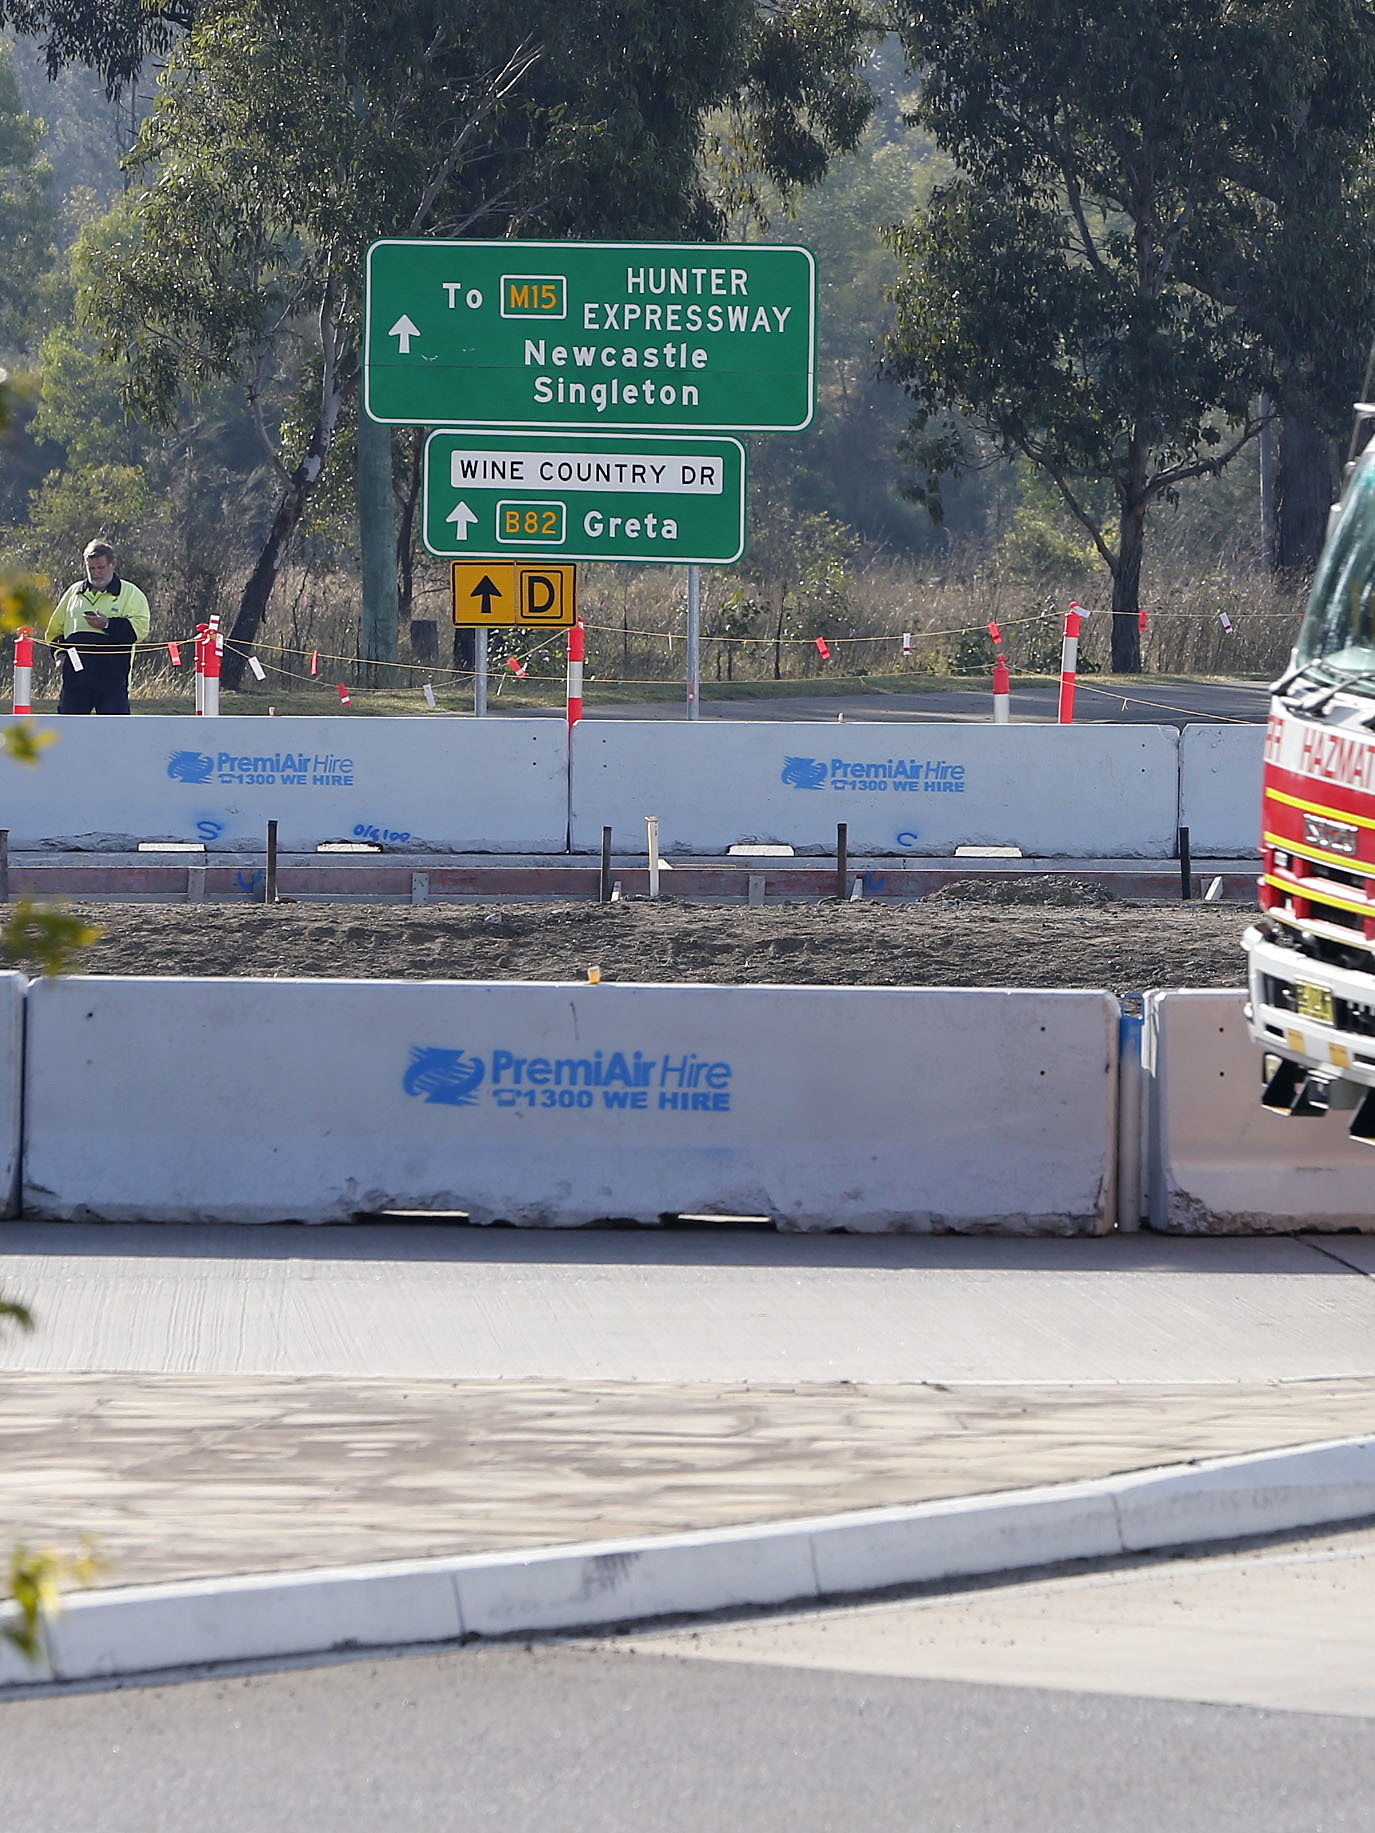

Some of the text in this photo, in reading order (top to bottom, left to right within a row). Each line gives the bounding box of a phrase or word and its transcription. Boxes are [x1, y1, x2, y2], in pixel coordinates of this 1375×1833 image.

[628, 268, 748, 295] HUNTER
[442, 282, 483, 309] To
[510, 284, 557, 309] M15
[584, 304, 792, 333] EXPRESSWAY
[524, 340, 708, 369] Newcastle
[534, 377, 699, 412] Singleton
[460, 459, 715, 486] WINE COUNTRY DR
[506, 512, 557, 534] B82
[583, 510, 678, 539] Greta
[528, 575, 555, 613] D
[217, 752, 354, 774] PremiAir Hire
[830, 758, 966, 780] PremiAir Hire
[236, 774, 354, 786] 1300 WE HIRE
[848, 780, 966, 792] 1300 WE HIRE
[492, 1050, 732, 1089] PremiAir Hire
[523, 1089, 731, 1112] 1300 WE HIRE
